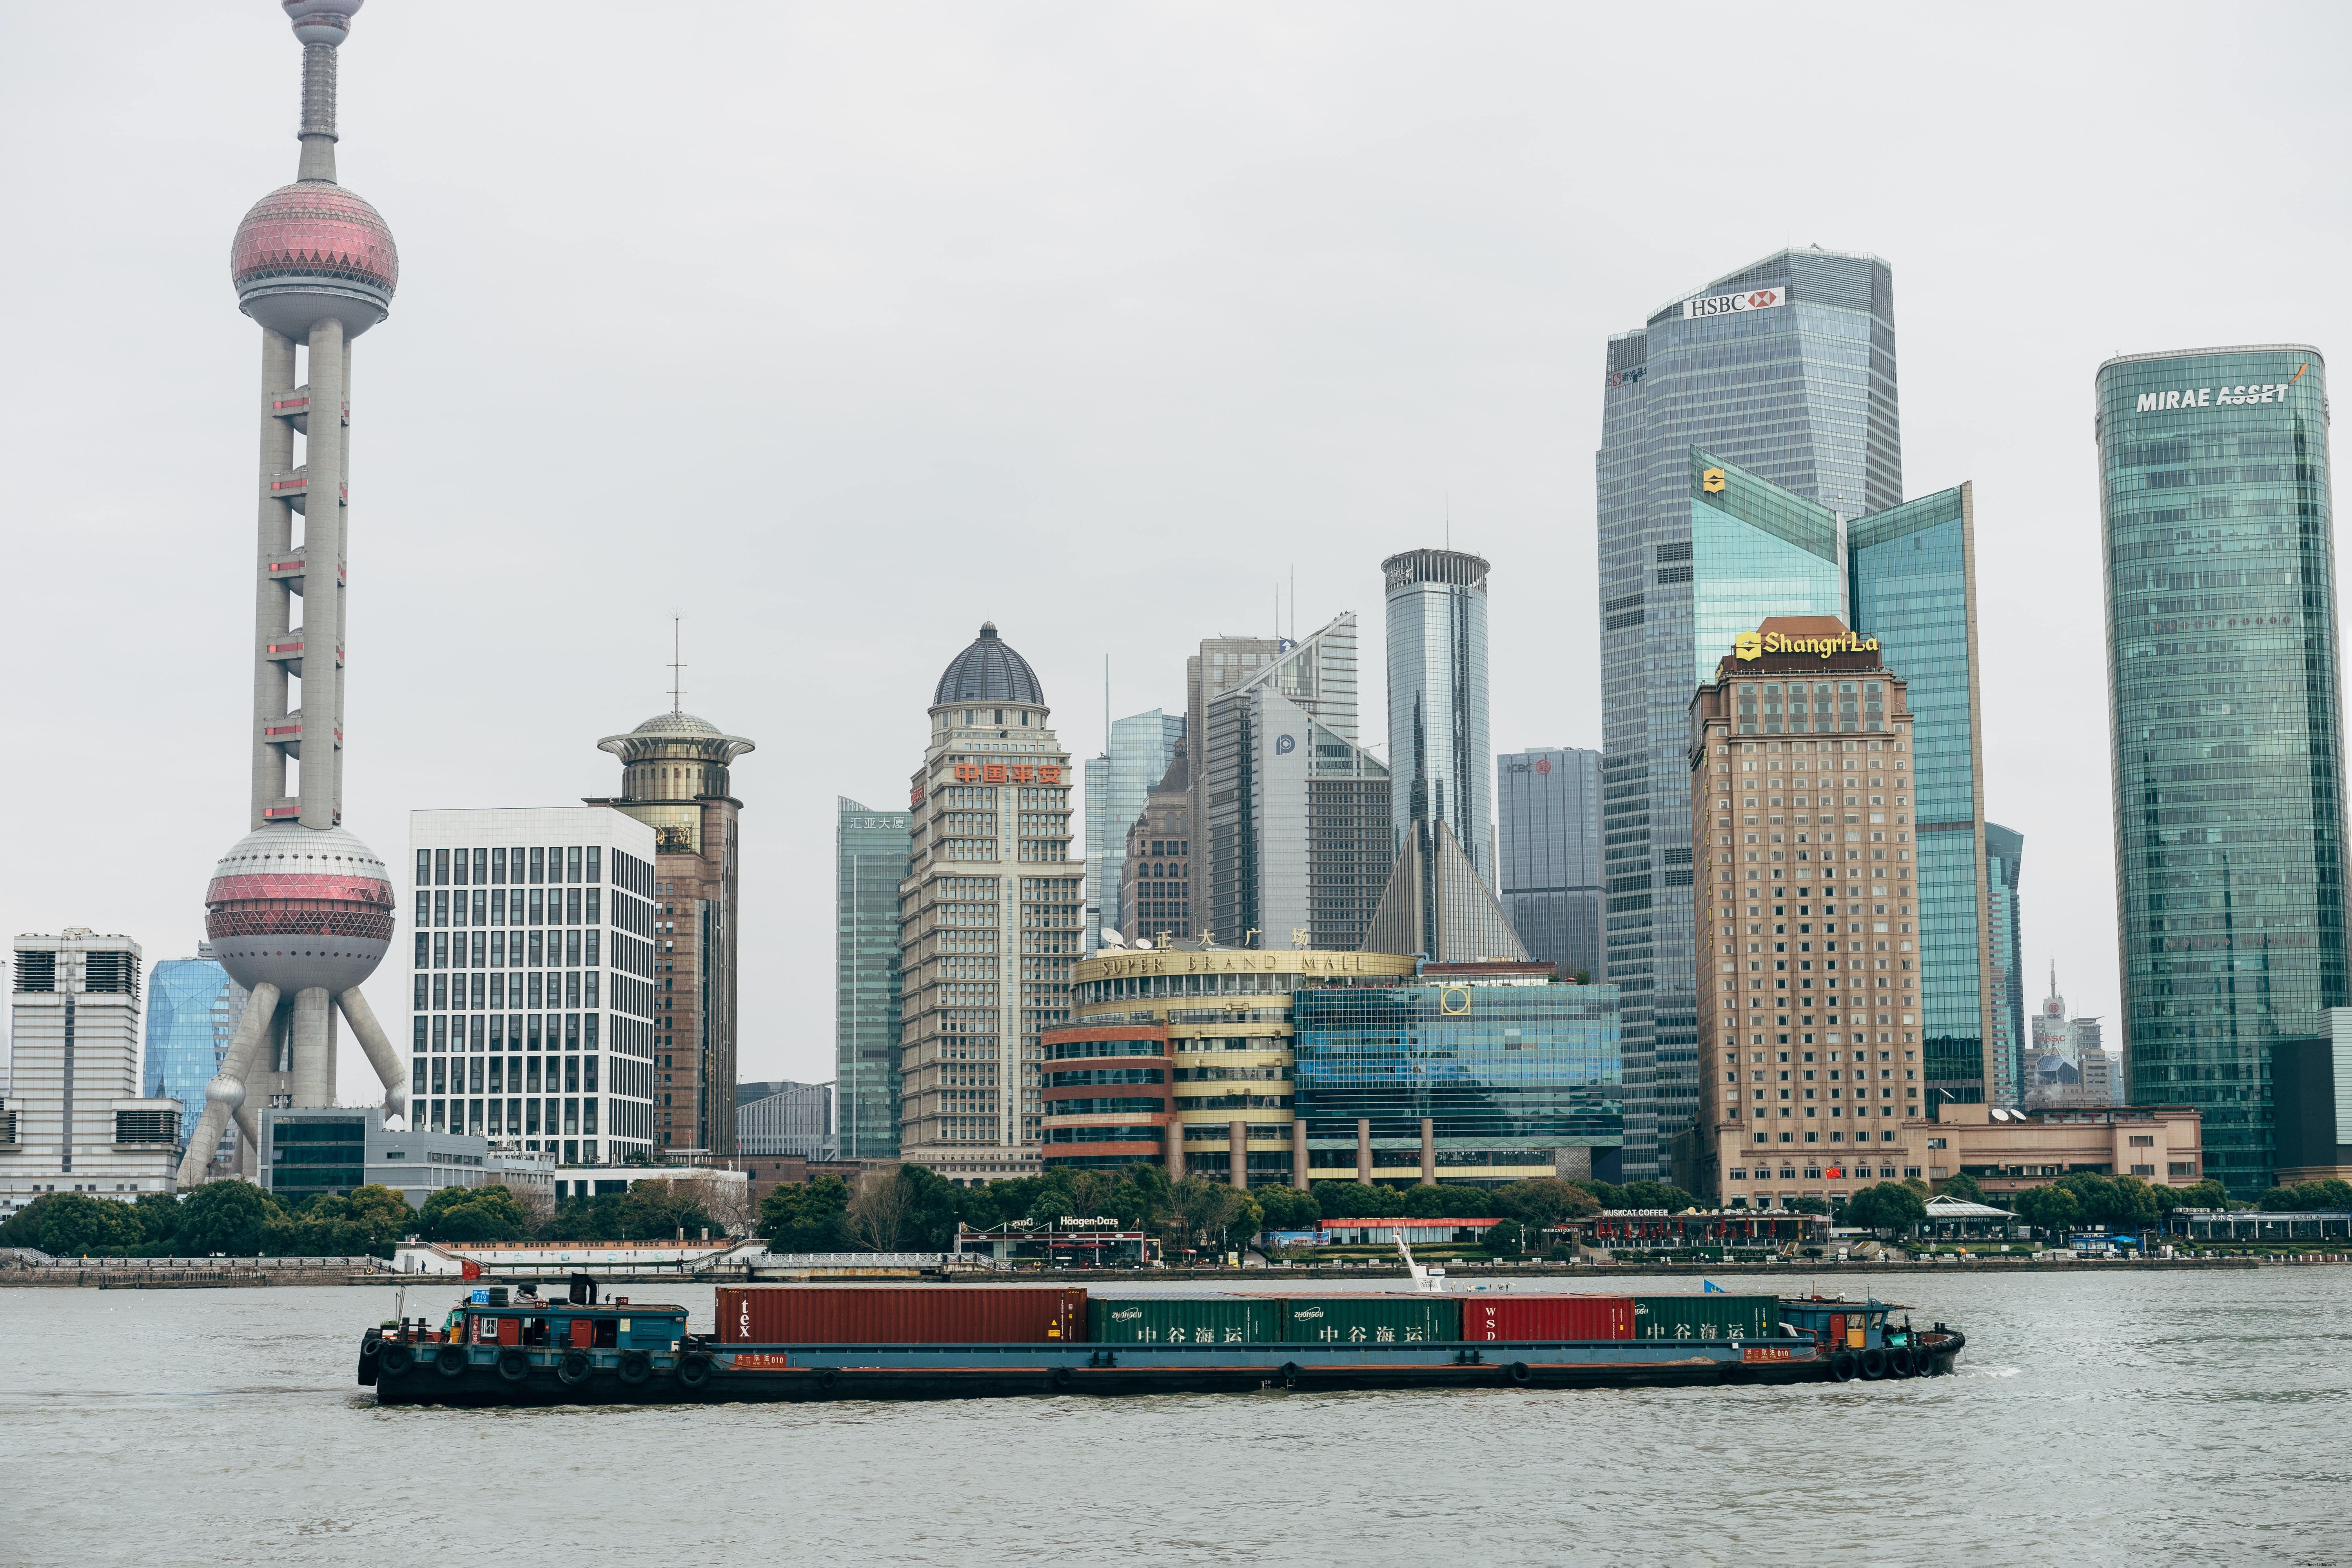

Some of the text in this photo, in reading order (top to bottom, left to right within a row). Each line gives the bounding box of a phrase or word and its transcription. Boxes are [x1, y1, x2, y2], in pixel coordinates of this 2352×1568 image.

[1691, 294, 1746, 317] HSBC
[2136, 384, 2288, 412] MIRAE ASSET
[1763, 631, 1878, 659] Shangri-La
[955, 762, 1062, 784] 中国平安
[1507, 763, 1533, 773] ICBC
[849, 817, 905, 829] 汇亚大厦
[1154, 927, 1309, 949] 正大广场
[1103, 955, 1365, 975] SUPER BRAND MALL
[739, 1299, 750, 1338] tex
[1485, 1307, 1497, 1341] WSD
[1138, 1326, 1243, 1343] 中谷海运
[1320, 1325, 1423, 1343] 中谷海运
[1648, 1323, 1744, 1339] 中谷海运
